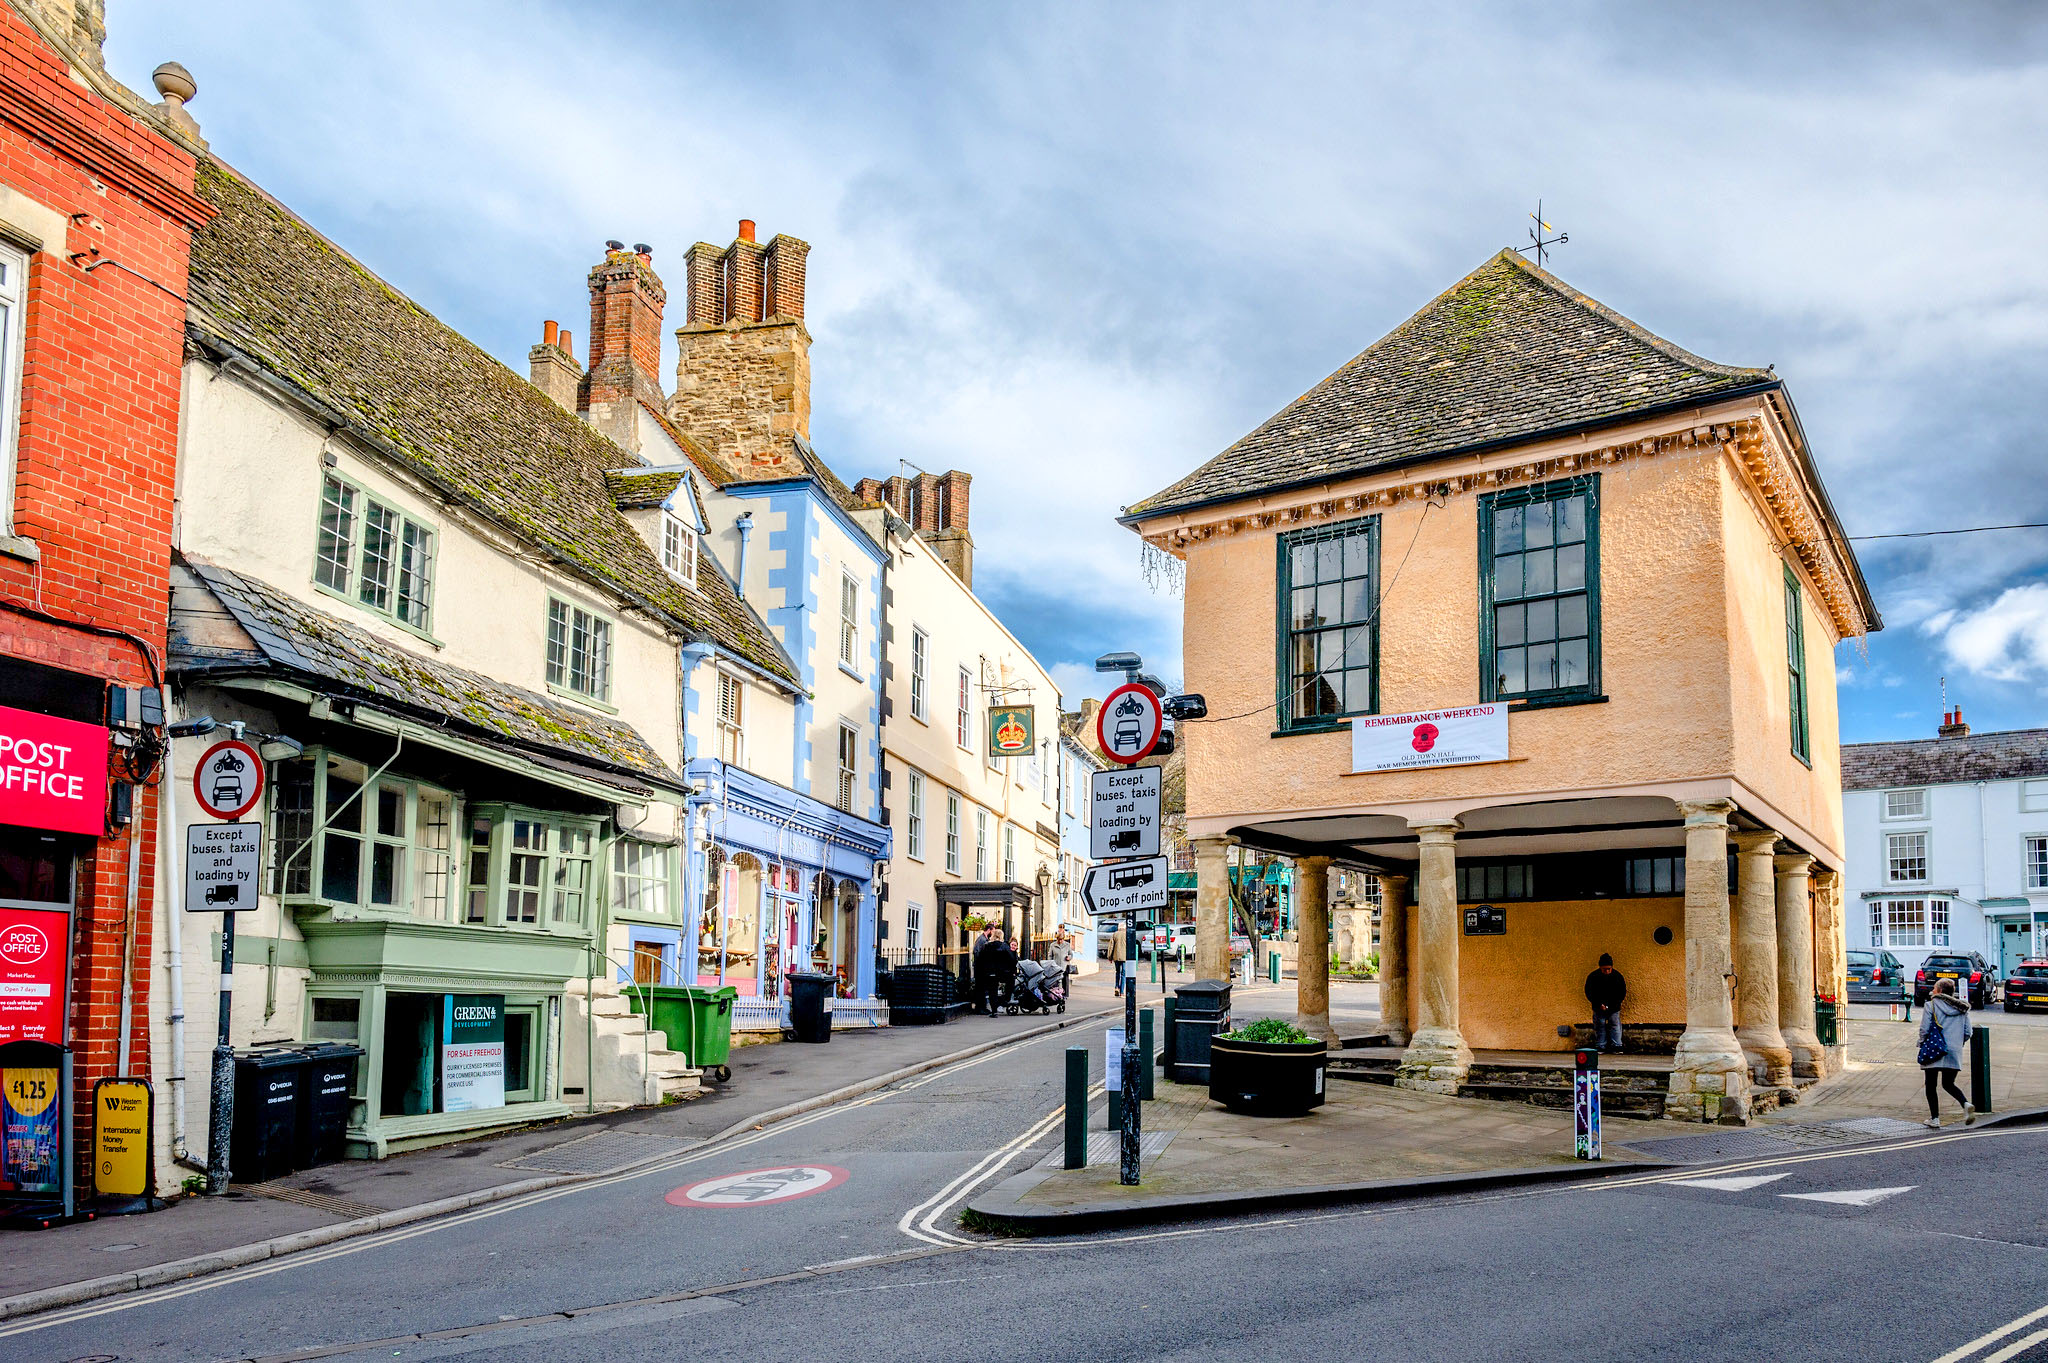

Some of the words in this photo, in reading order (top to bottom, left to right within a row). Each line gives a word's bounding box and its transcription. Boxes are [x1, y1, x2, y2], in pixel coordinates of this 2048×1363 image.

[1365, 712, 1440, 728] REMEMBRANCE
[1443, 706, 1495, 719] WEEKEND
[0, 735, 71, 769] POST
[1417, 752, 1436, 760] TOWN
[1441, 755, 1481, 764] EXHIBITION
[0, 765, 83, 800] FFICE
[1109, 774, 1144, 787] Except
[1132, 787, 1156, 799] taxis
[1116, 802, 1134, 813] and
[1099, 816, 1135, 828] loading
[1139, 814, 1151, 826] by
[206, 829, 242, 841] Except
[230, 842, 255, 853] taxis
[213, 856, 232, 867] and
[195, 870, 233, 881] loading
[237, 869, 250, 881] by
[1141, 891, 1164, 904] point
[10, 933, 38, 944] POST
[3, 943, 41, 954] OFFICE
[454, 1006, 491, 1020] GREEN
[447, 1050, 458, 1058] FOR
[460, 1049, 473, 1058] SALE
[474, 1048, 502, 1057] FREEHOLD
[463, 1062, 482, 1070] LICENSED
[13, 1080, 46, 1100] £1.25
[103, 1126, 141, 1134] International
[103, 1136, 123, 1144] Money
[103, 1145, 128, 1153] Transfer
